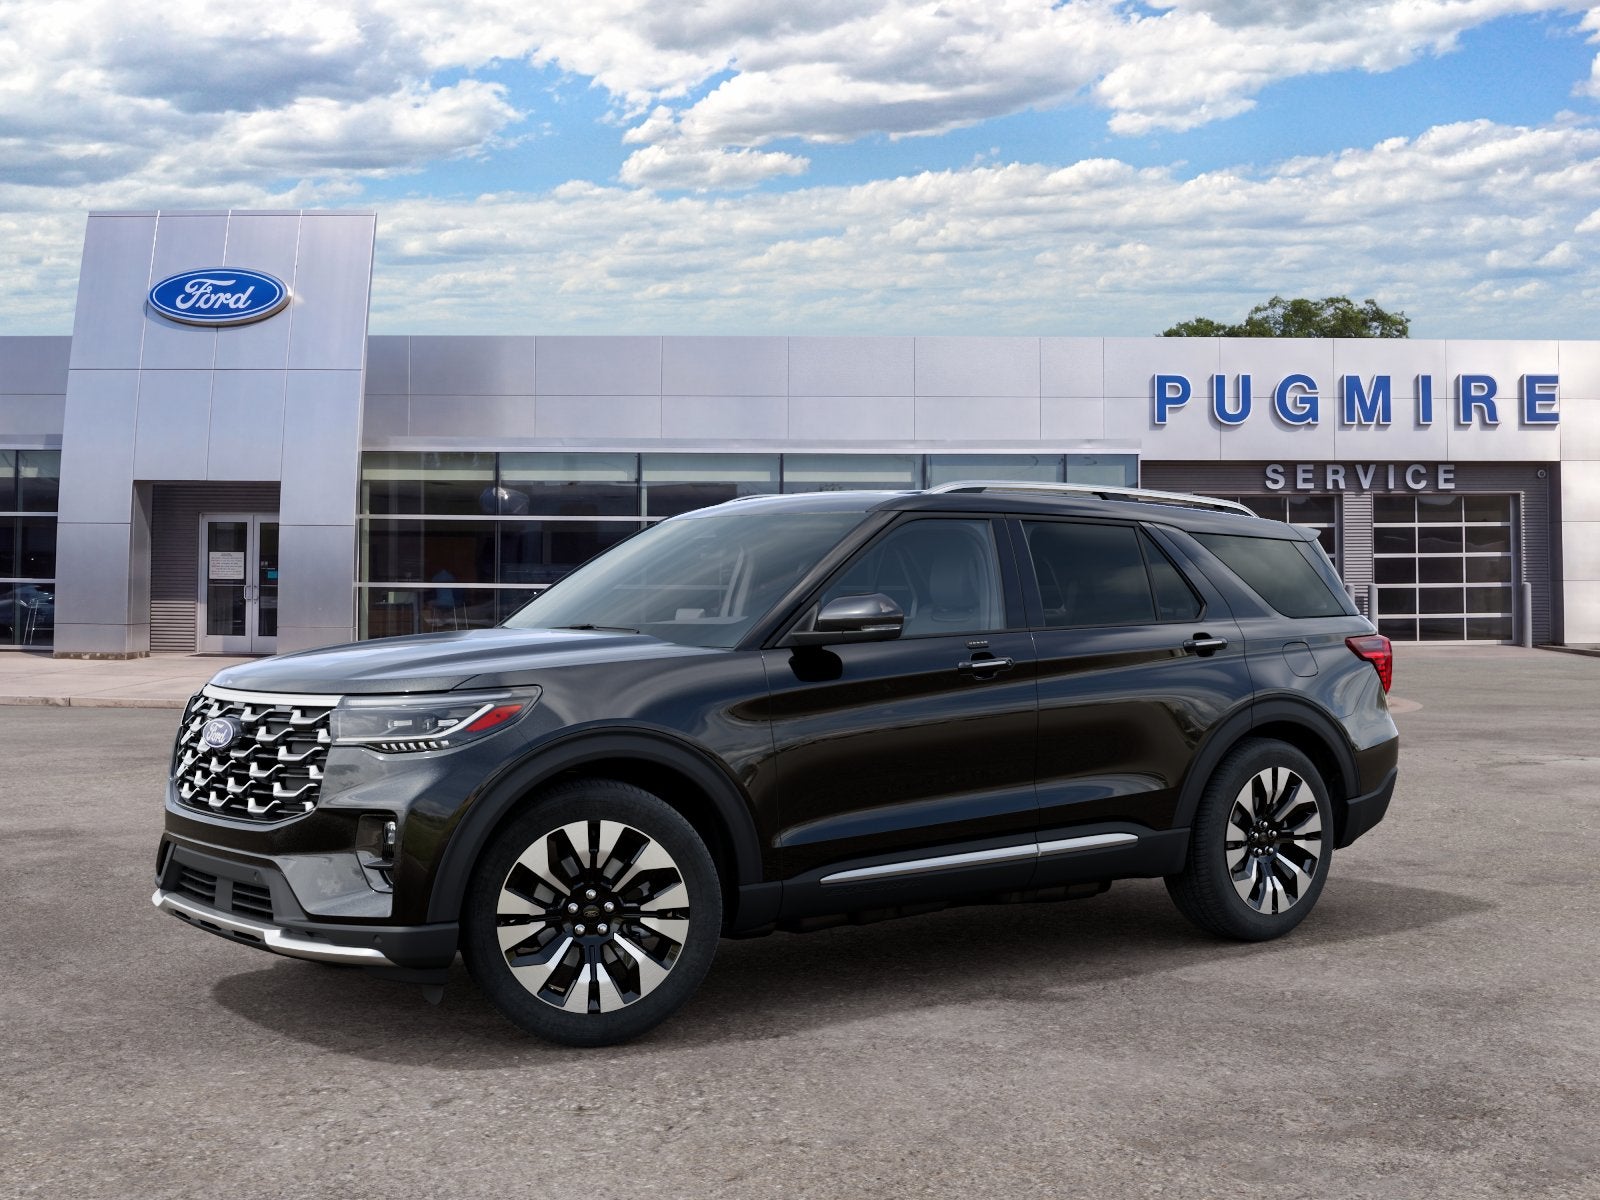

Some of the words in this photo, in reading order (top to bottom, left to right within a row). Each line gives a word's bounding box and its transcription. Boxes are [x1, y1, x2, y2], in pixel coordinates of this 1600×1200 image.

[175, 278, 255, 310] Ford
[1153, 373, 1560, 426] PUGMIRE
[1265, 463, 1456, 491] SERVICE
[206, 722, 228, 743] Ford
